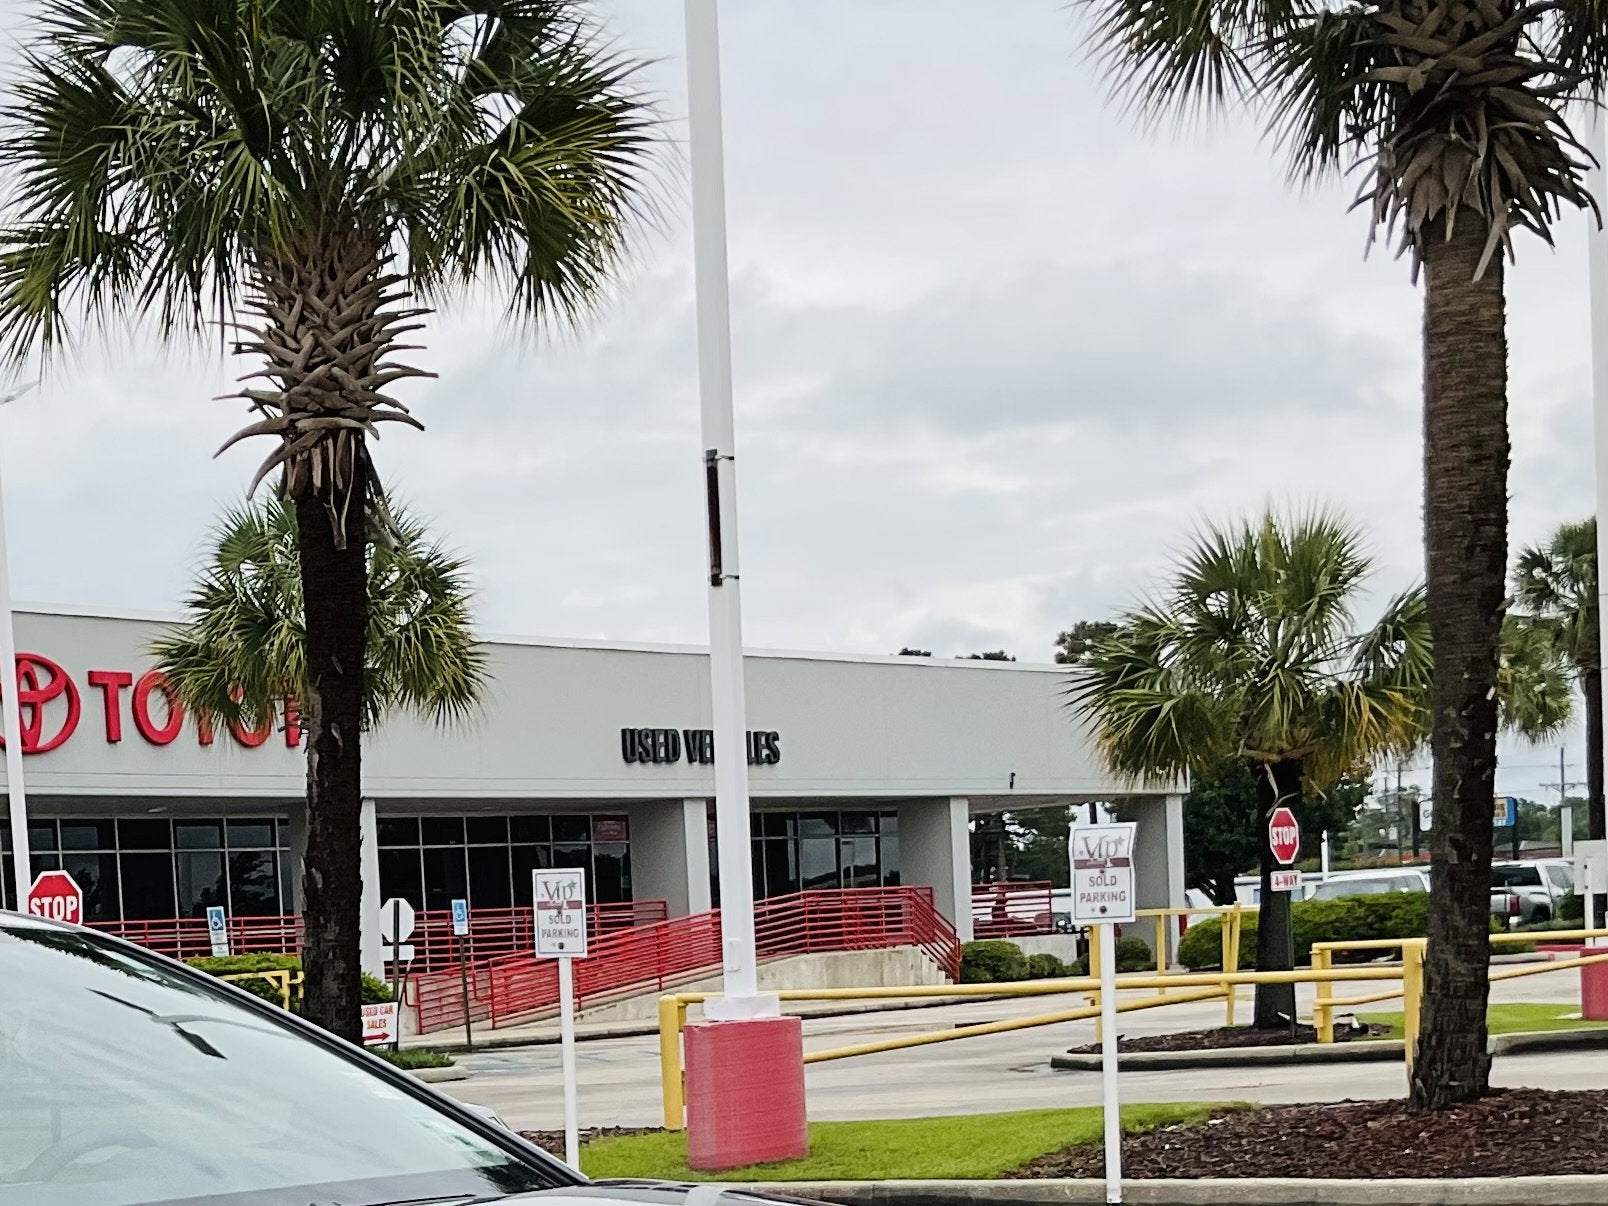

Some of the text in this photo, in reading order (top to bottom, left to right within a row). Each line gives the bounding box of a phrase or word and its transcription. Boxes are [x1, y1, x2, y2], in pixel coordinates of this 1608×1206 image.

[621, 728, 781, 765] USED VELES
[1272, 826, 1296, 846] STOP
[1089, 875, 1117, 887] SOLD
[1275, 874, 1298, 887] 4-WAY
[1080, 890, 1126, 904] PARKING
[31, 895, 78, 921] STOP
[548, 914, 572, 925] SOLD
[541, 928, 580, 939] PARKING
